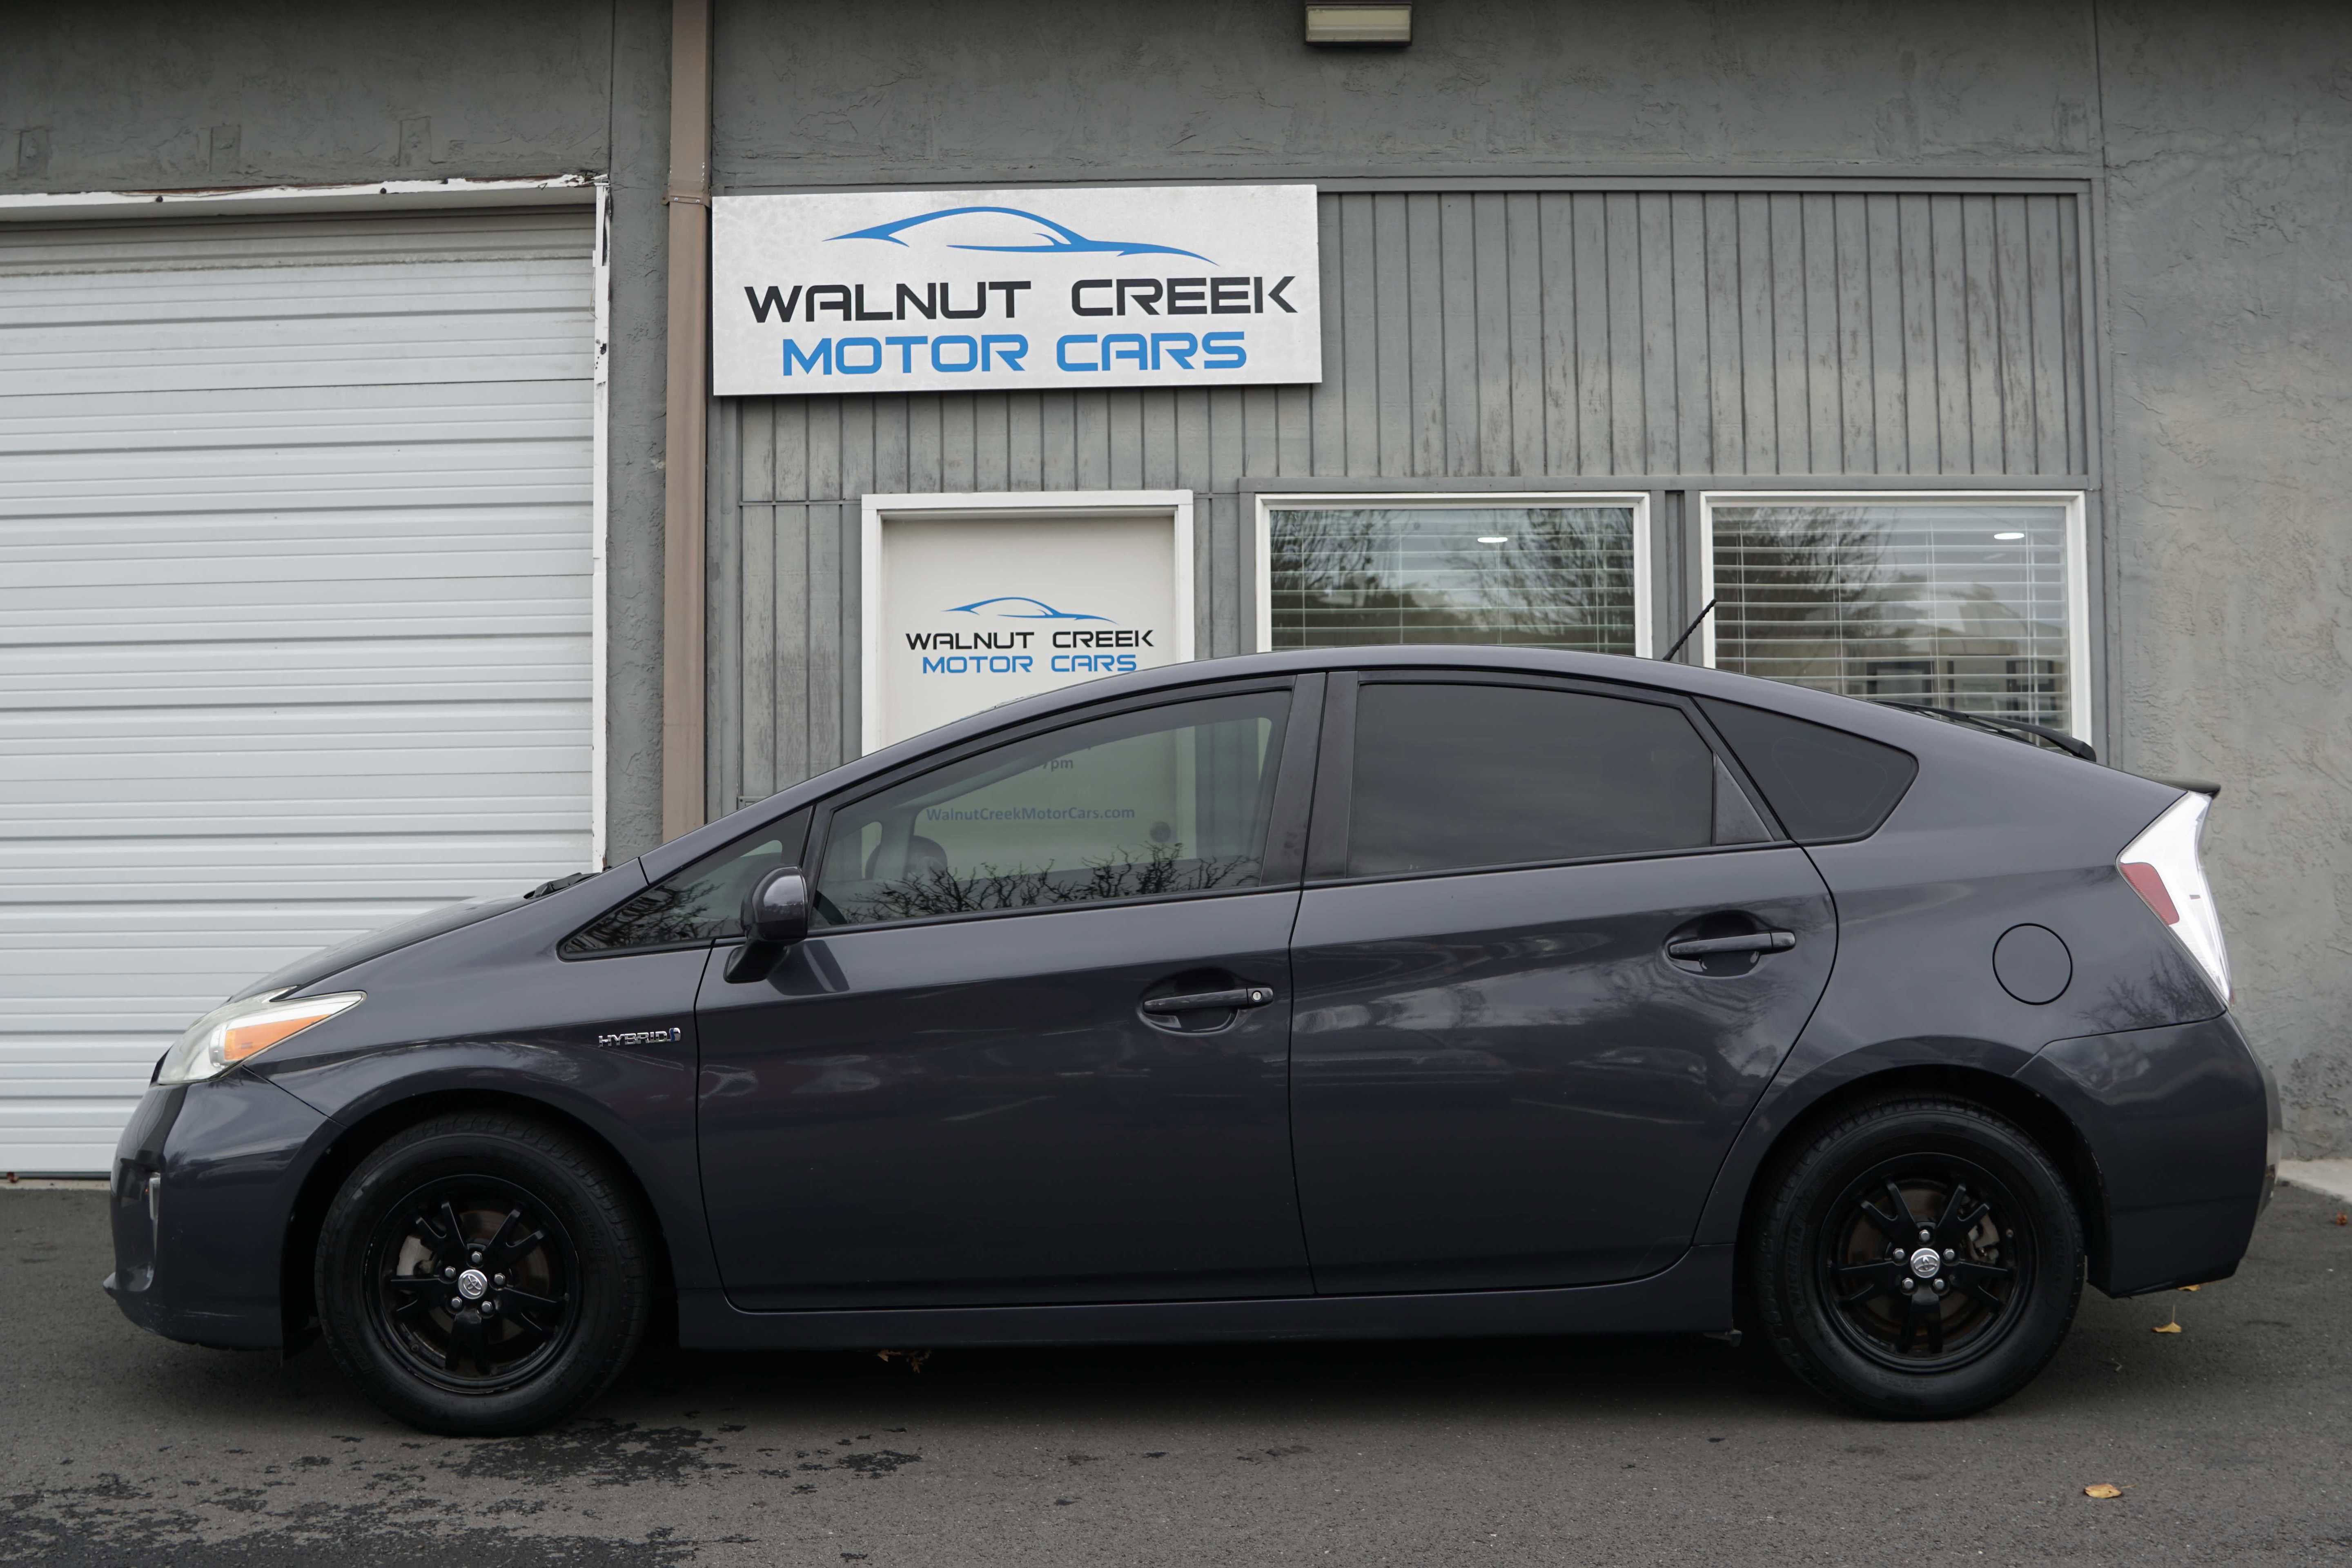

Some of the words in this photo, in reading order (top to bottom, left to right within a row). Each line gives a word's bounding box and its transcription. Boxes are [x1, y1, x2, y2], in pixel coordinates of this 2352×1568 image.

[744, 281, 1031, 323] WALNUT
[1071, 276, 1298, 316] CREEK
[783, 334, 1029, 376] MOTOR
[1056, 331, 1247, 372] CARS
[905, 632, 1035, 650] WALNUT
[1052, 630, 1154, 648] CREEK
[922, 655, 1033, 674] MOTOR
[1051, 654, 1137, 673] CARS
[926, 806, 1135, 821] WalnutCreekMotorCars.com
[598, 1031, 668, 1049] HYBRID
